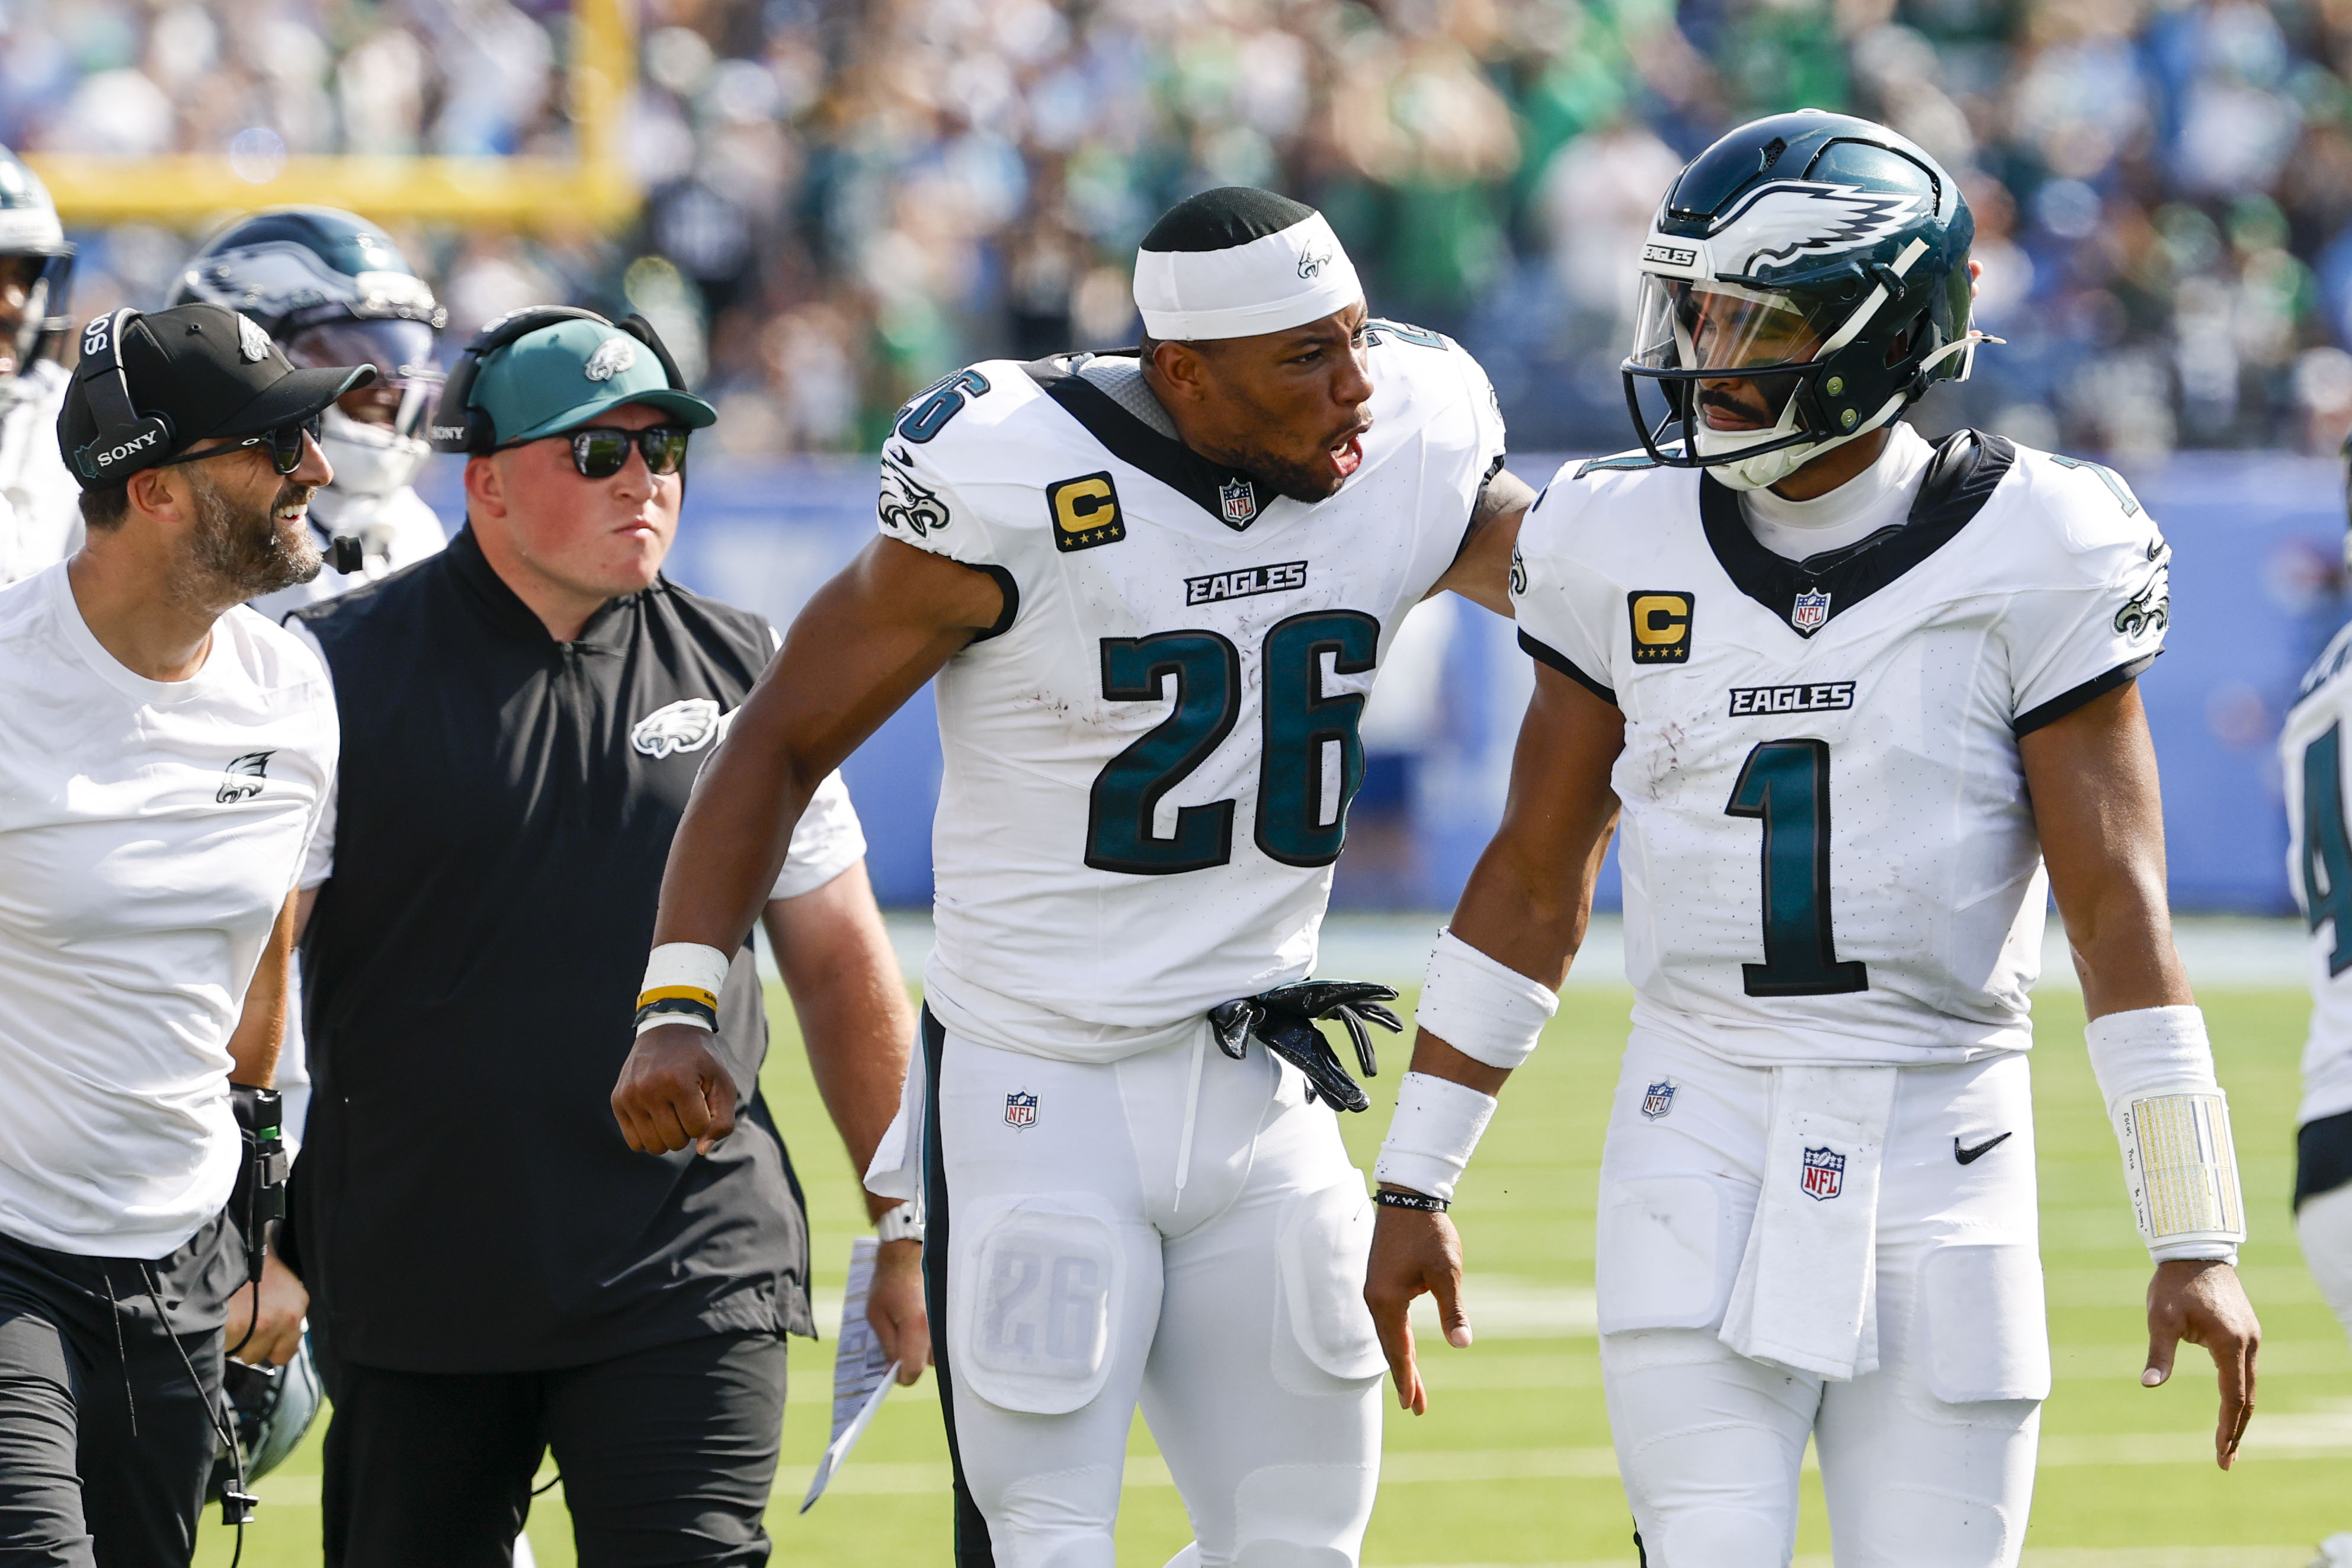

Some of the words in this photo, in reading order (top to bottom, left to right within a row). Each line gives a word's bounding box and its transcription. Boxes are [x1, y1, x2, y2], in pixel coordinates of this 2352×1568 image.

[1643, 246, 1696, 265] EAGLES
[97, 430, 157, 467] SONY
[1055, 478, 1116, 533] C
[1228, 499, 1251, 517] NFL
[1188, 563, 1305, 604] EAGLES
[1633, 595, 1688, 645] C
[1797, 607, 1821, 624] NFL
[1733, 684, 1853, 714] EAGLES
[1084, 609, 1381, 875] 26
[1724, 738, 1869, 997] 1
[1007, 1106, 1033, 1123] NFL
[1645, 1096, 1667, 1112] NFL
[2123, 1112, 2133, 1137] FOCUS
[1804, 1166, 1838, 1195] NFL
[985, 1249, 1099, 1359] 26
